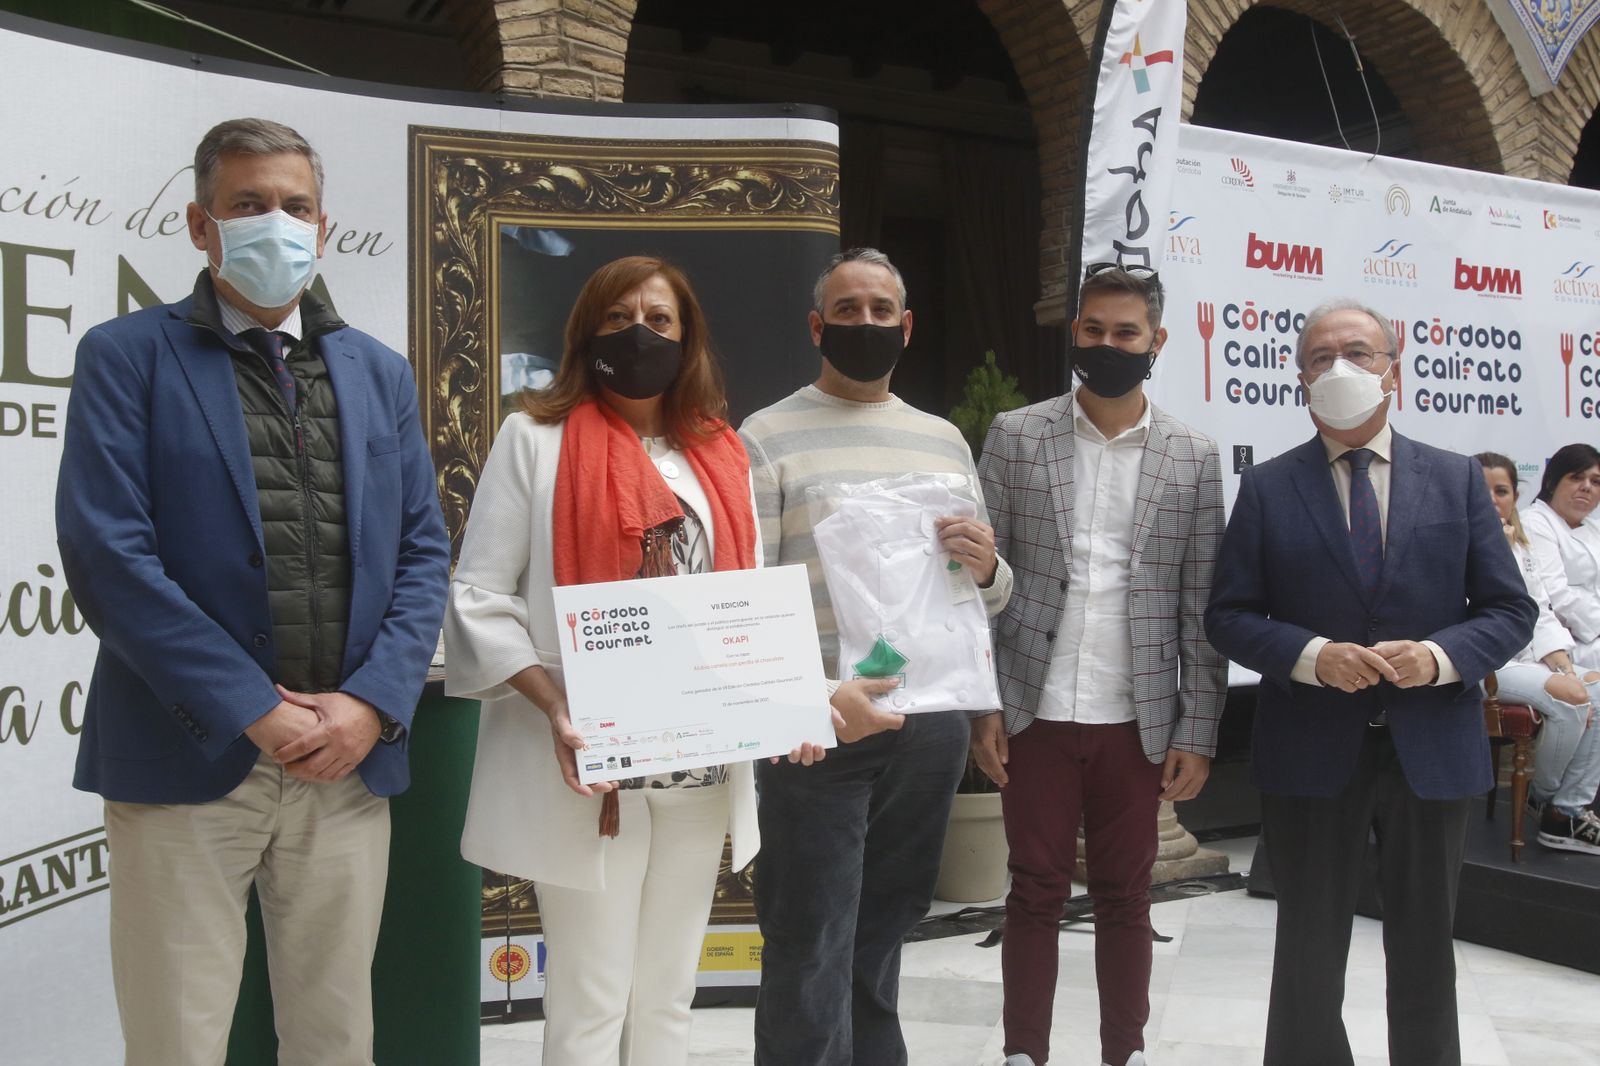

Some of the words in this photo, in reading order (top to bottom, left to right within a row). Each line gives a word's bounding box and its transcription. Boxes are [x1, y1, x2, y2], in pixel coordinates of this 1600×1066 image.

[1442, 199, 1457, 207] Junta
[1363, 256, 1418, 280] activa
[1224, 337, 1292, 370] Calif
[1414, 351, 1522, 383] Califato
[1415, 388, 1522, 416] Gourmet
[583, 621, 650, 636] Califato
[585, 634, 652, 651] Gourmet
[722, 635, 749, 645] OKAPI
